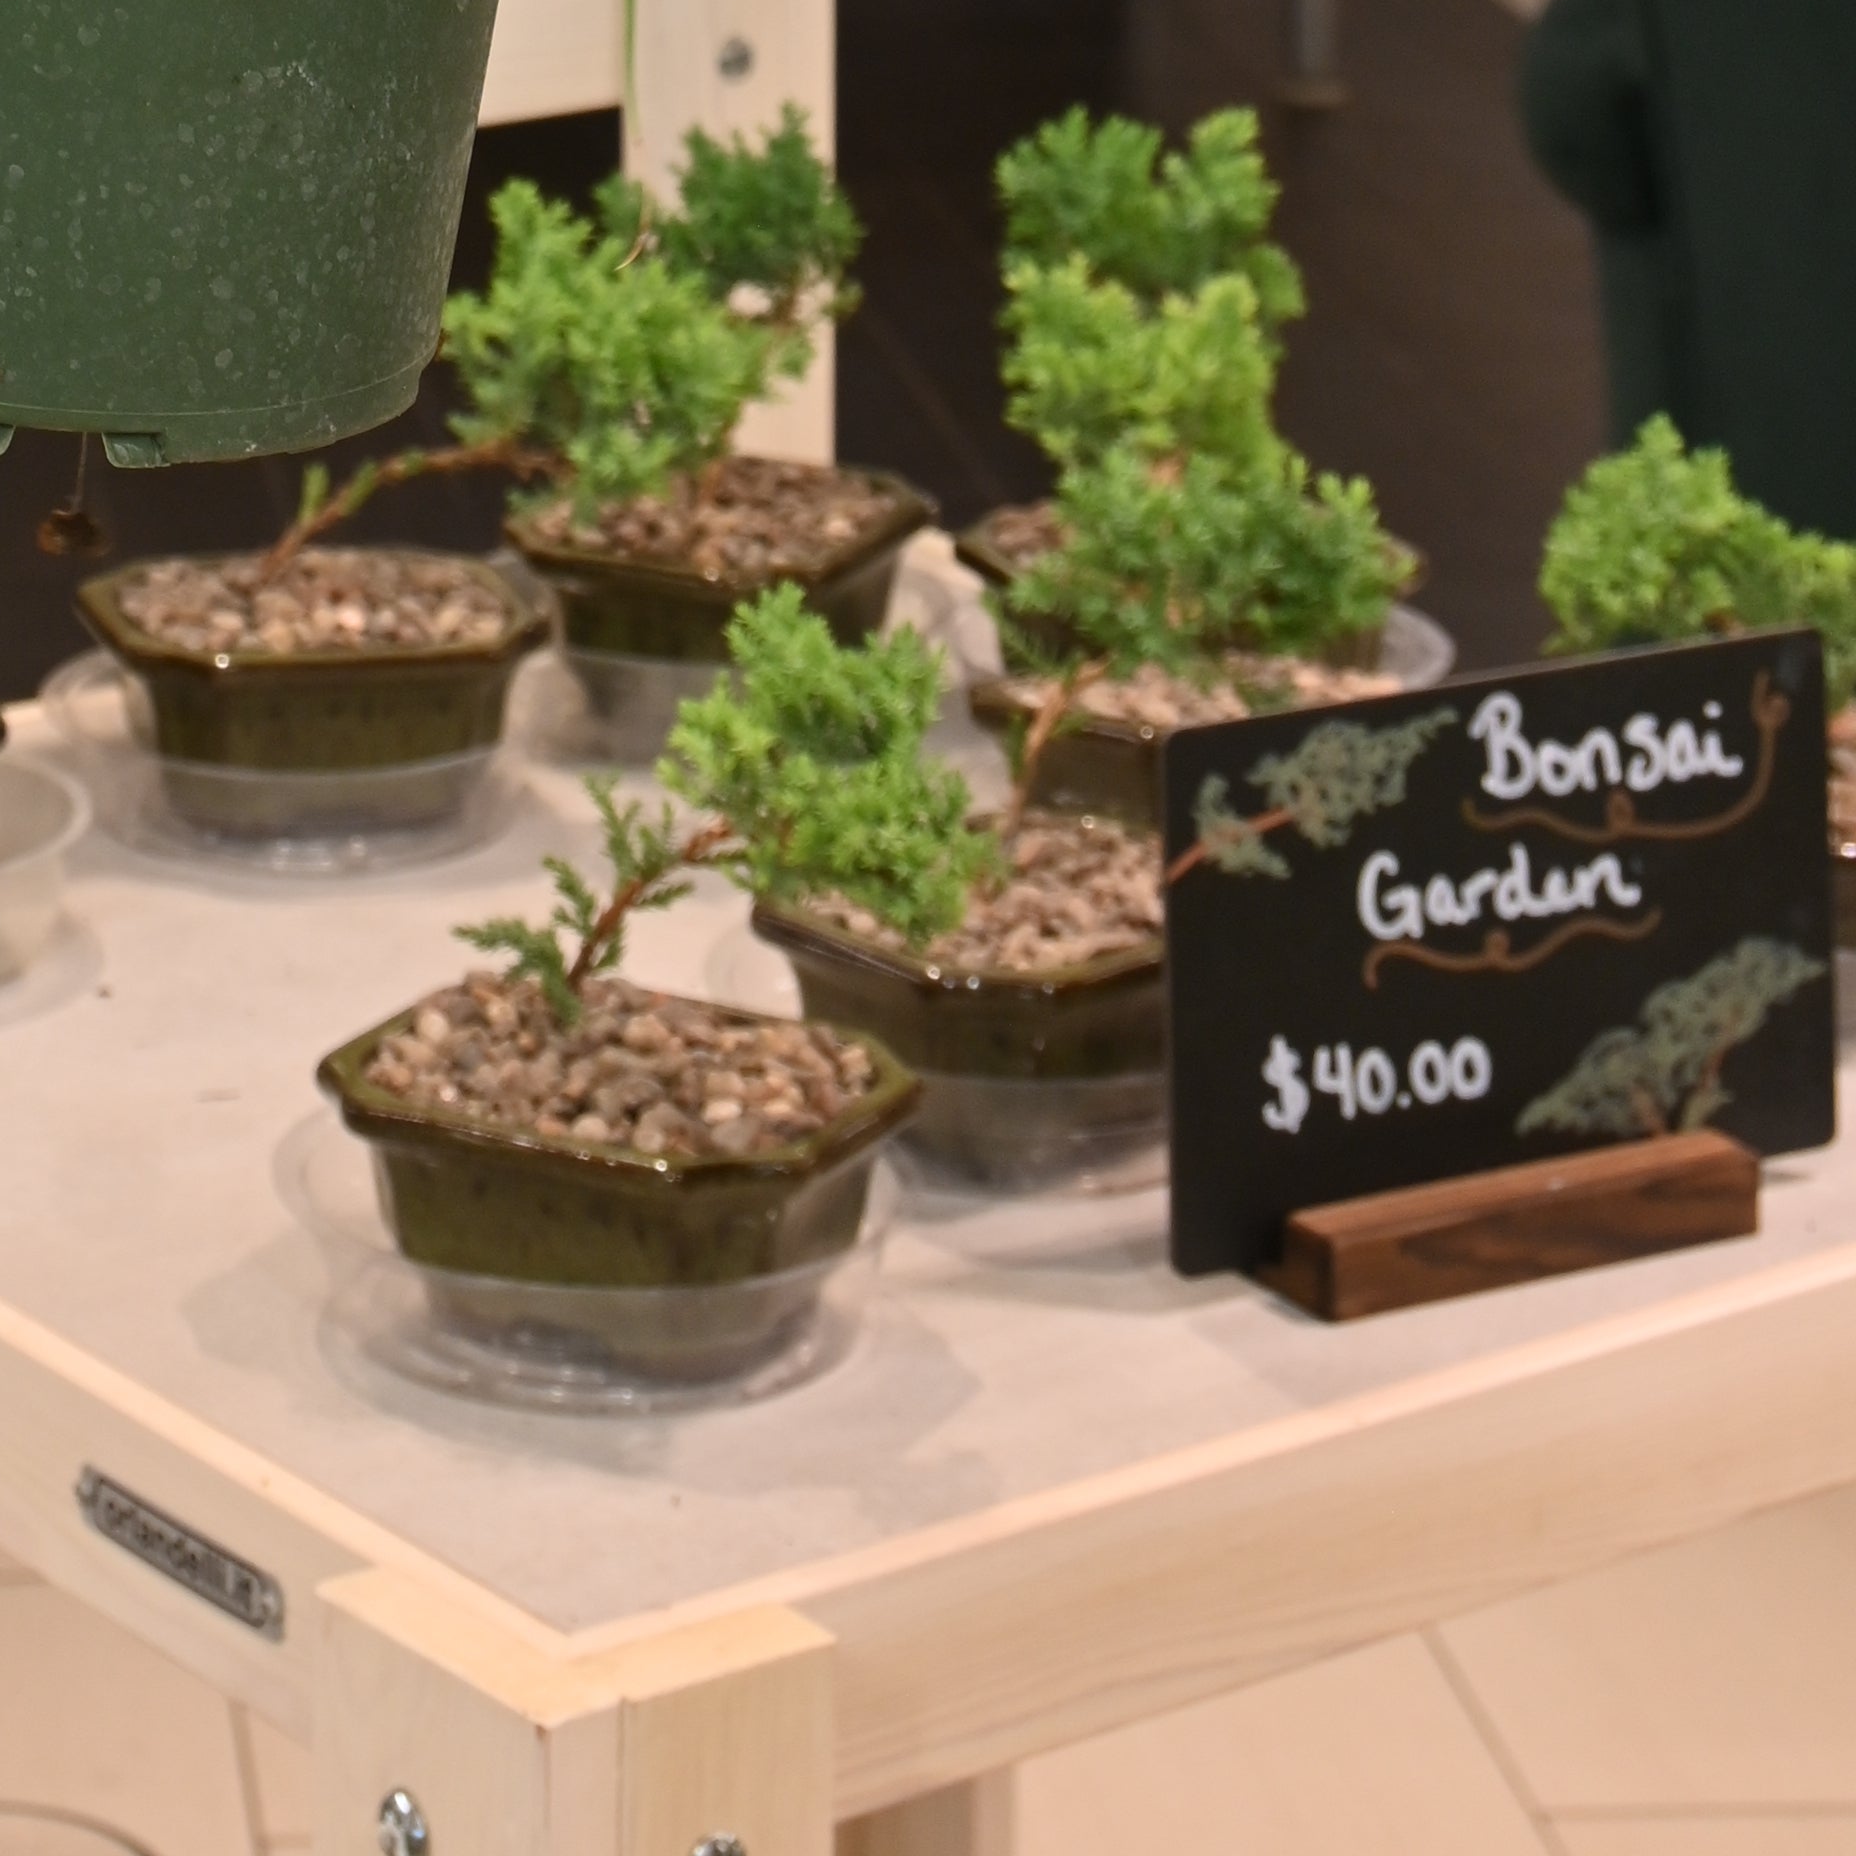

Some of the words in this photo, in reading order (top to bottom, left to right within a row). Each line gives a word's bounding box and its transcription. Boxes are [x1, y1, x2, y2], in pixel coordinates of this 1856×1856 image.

[1468, 690, 1743, 800] Bonsai
[1357, 844, 1642, 941] Garden
[1262, 1034, 1492, 1135] $40.00
